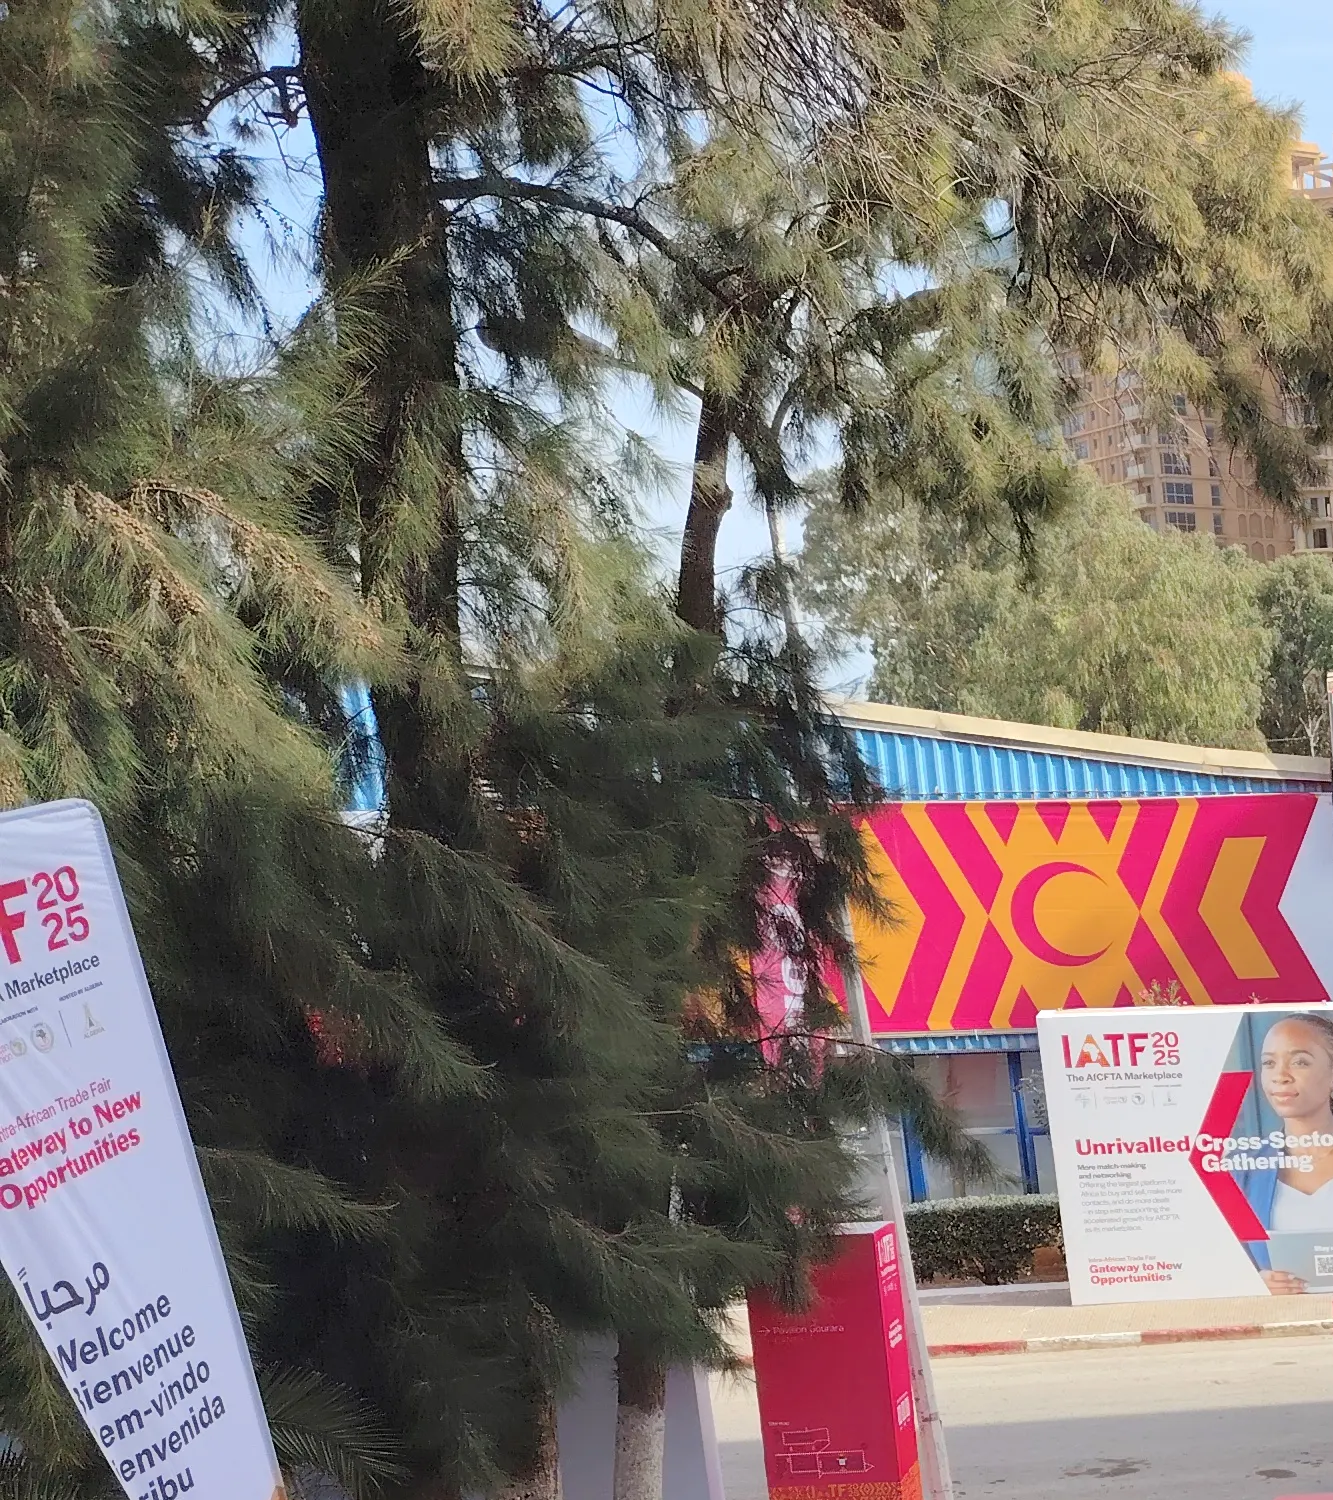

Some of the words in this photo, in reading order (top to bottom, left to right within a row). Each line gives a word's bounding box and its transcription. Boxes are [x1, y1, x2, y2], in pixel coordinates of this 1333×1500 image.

[32, 865, 80, 911] 20
[41, 902, 90, 952] 25
[4, 955, 100, 1000] Marketplace
[1061, 1032, 1148, 1068] IATF
[1151, 1031, 1178, 1048] 20
[1153, 1049, 1181, 1066] 25
[1066, 1074, 1085, 1083] The
[1086, 1073, 1122, 1082] AfCFTA
[1124, 1072, 1183, 1081] Marketplace
[0, 1105, 57, 1141] ntra-African
[55, 1089, 89, 1112] Trade
[90, 1077, 111, 1097] Fair
[0, 1128, 67, 1177] ateway
[69, 1117, 93, 1139] to
[92, 1091, 141, 1128] New
[1075, 1135, 1190, 1156] Unrivalled
[0, 1128, 140, 1210] Opportunities
[1201, 1152, 1314, 1172] Gathering
[1089, 1264, 1139, 1274] Gateway
[1142, 1263, 1154, 1271] to
[1157, 1261, 1182, 1271] New
[1090, 1273, 1172, 1286] Opportunities
[98, 1360, 210, 1448] em-vindo
